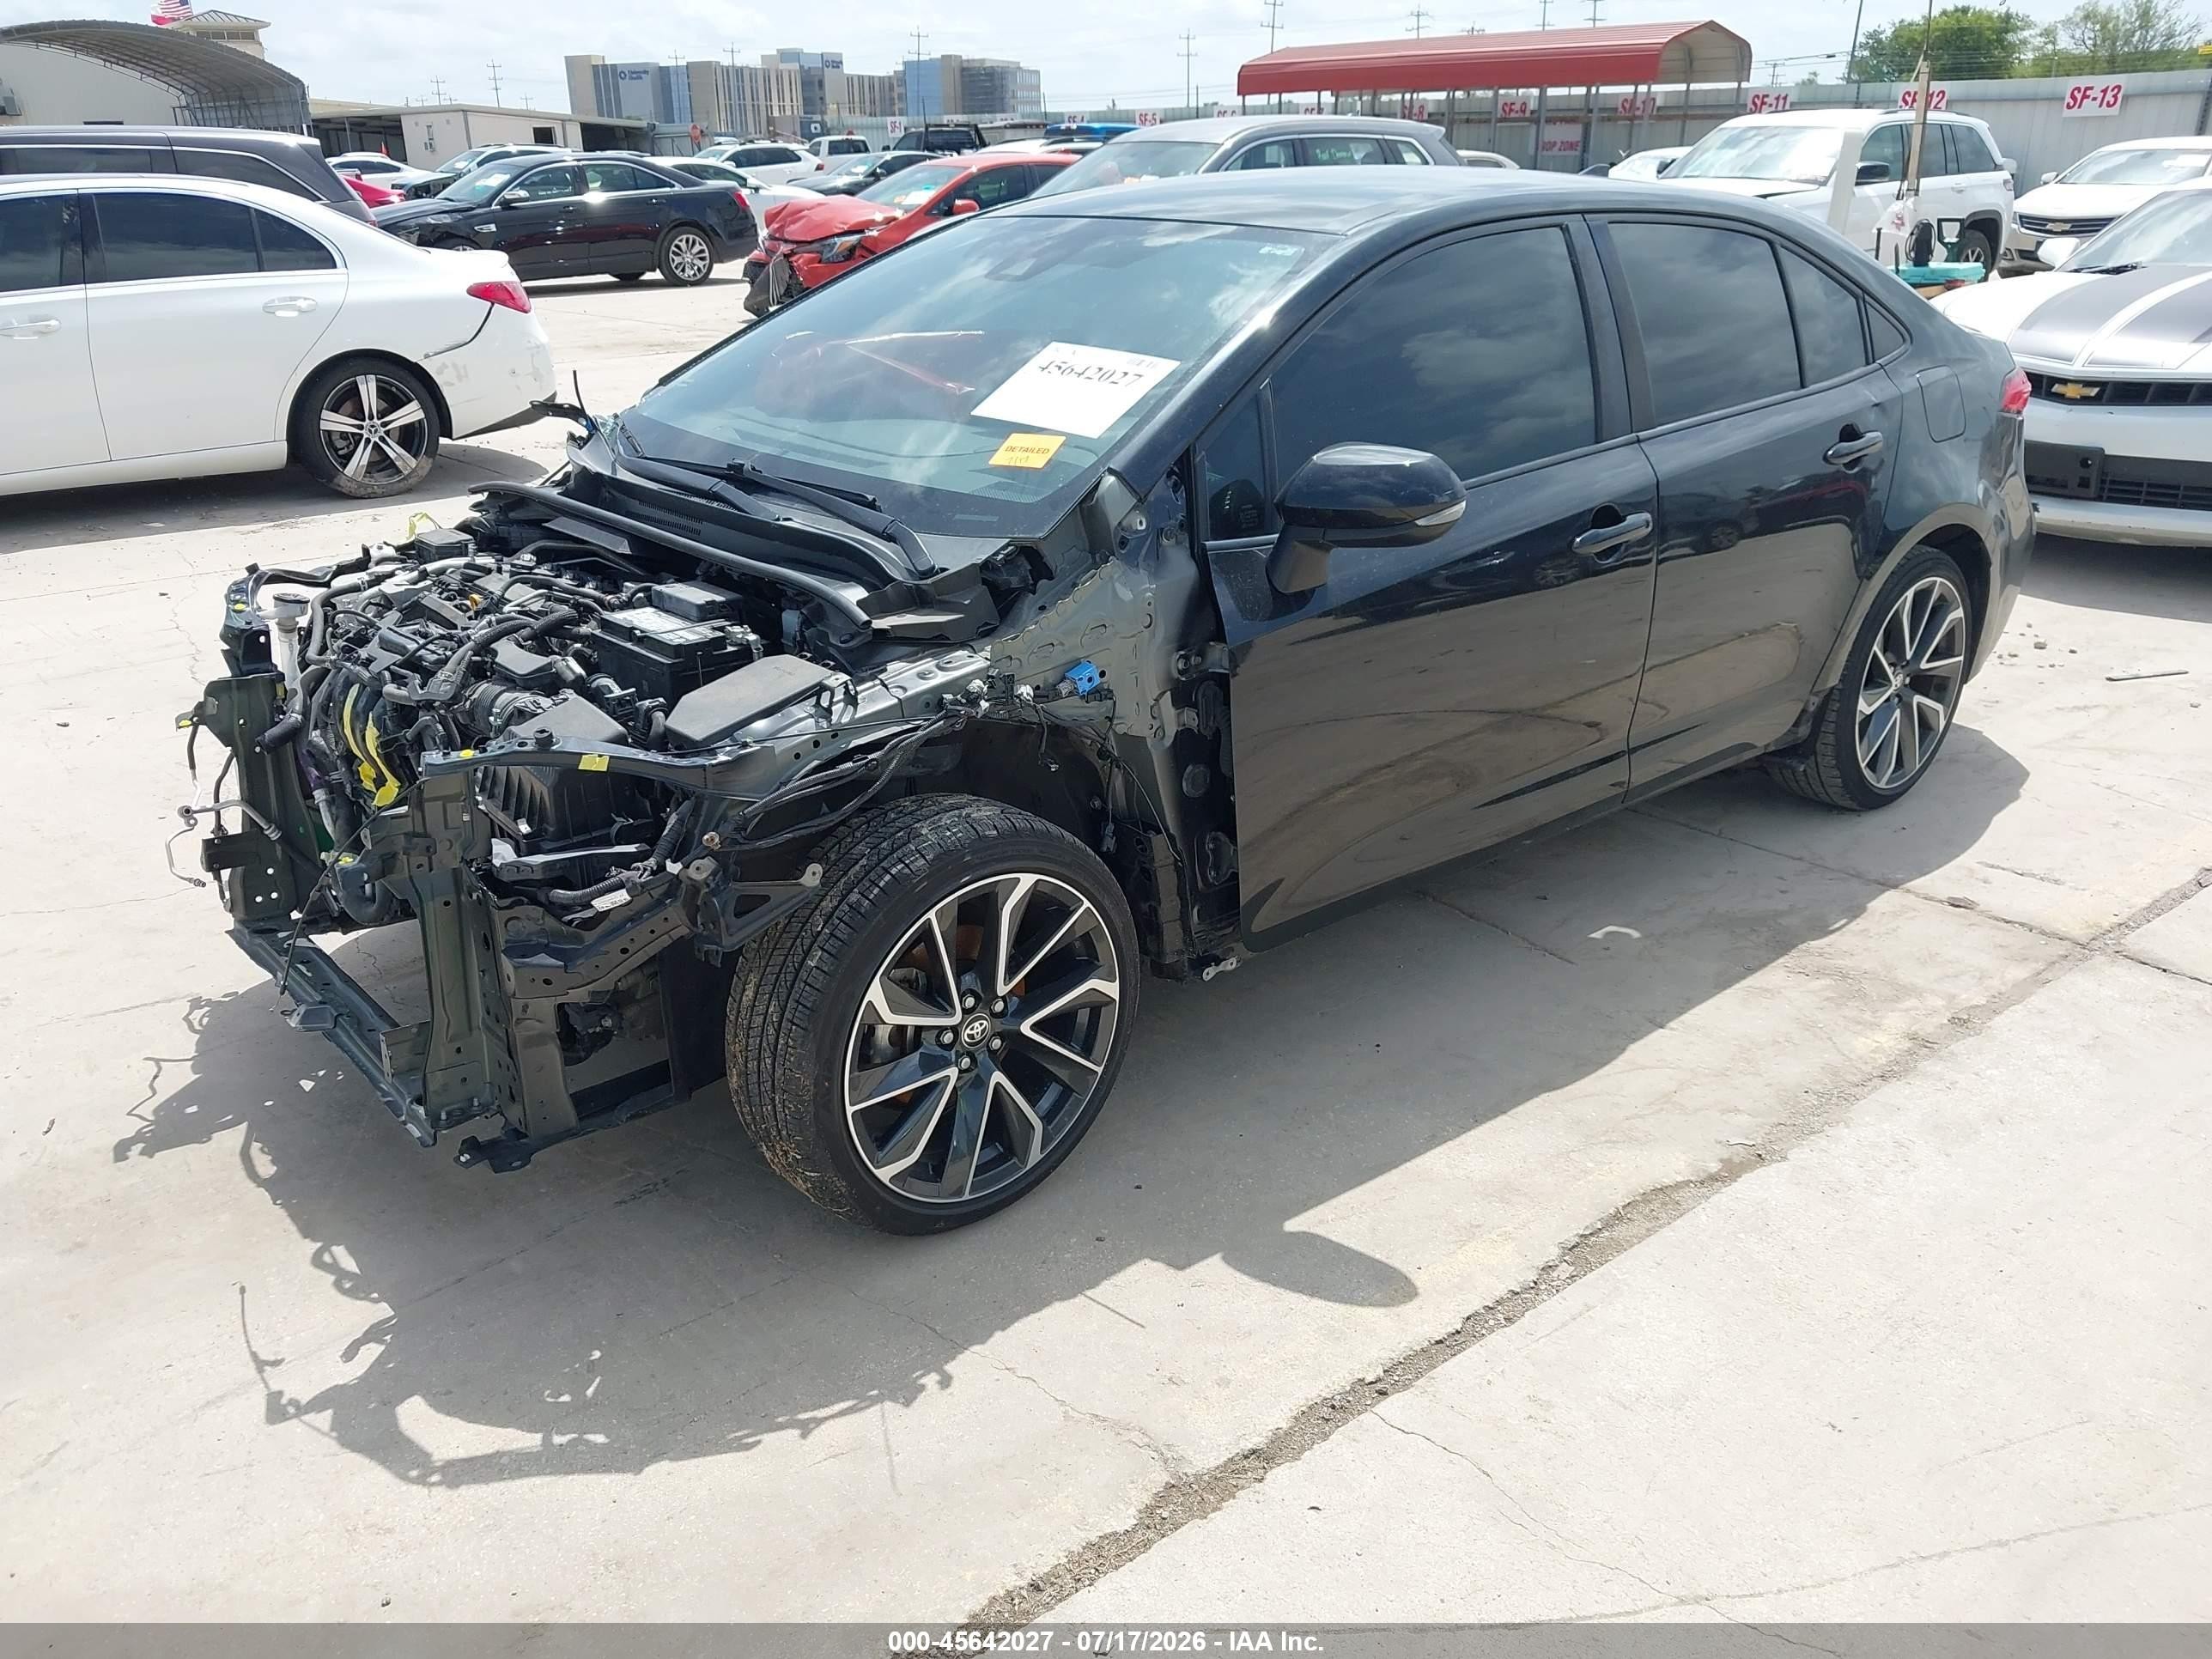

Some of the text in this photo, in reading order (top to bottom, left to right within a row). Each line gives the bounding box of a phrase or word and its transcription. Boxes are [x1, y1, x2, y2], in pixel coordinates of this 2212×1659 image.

[1749, 94, 1789, 113] SF-11
[1899, 89, 1946, 109] SF12
[2066, 84, 2122, 110] SF-13
[1500, 101, 1527, 118] SF-9
[890, 120, 902, 133] SF-1
[1038, 360, 1145, 387] 45642027
[1005, 445, 1050, 454] DETAILED
